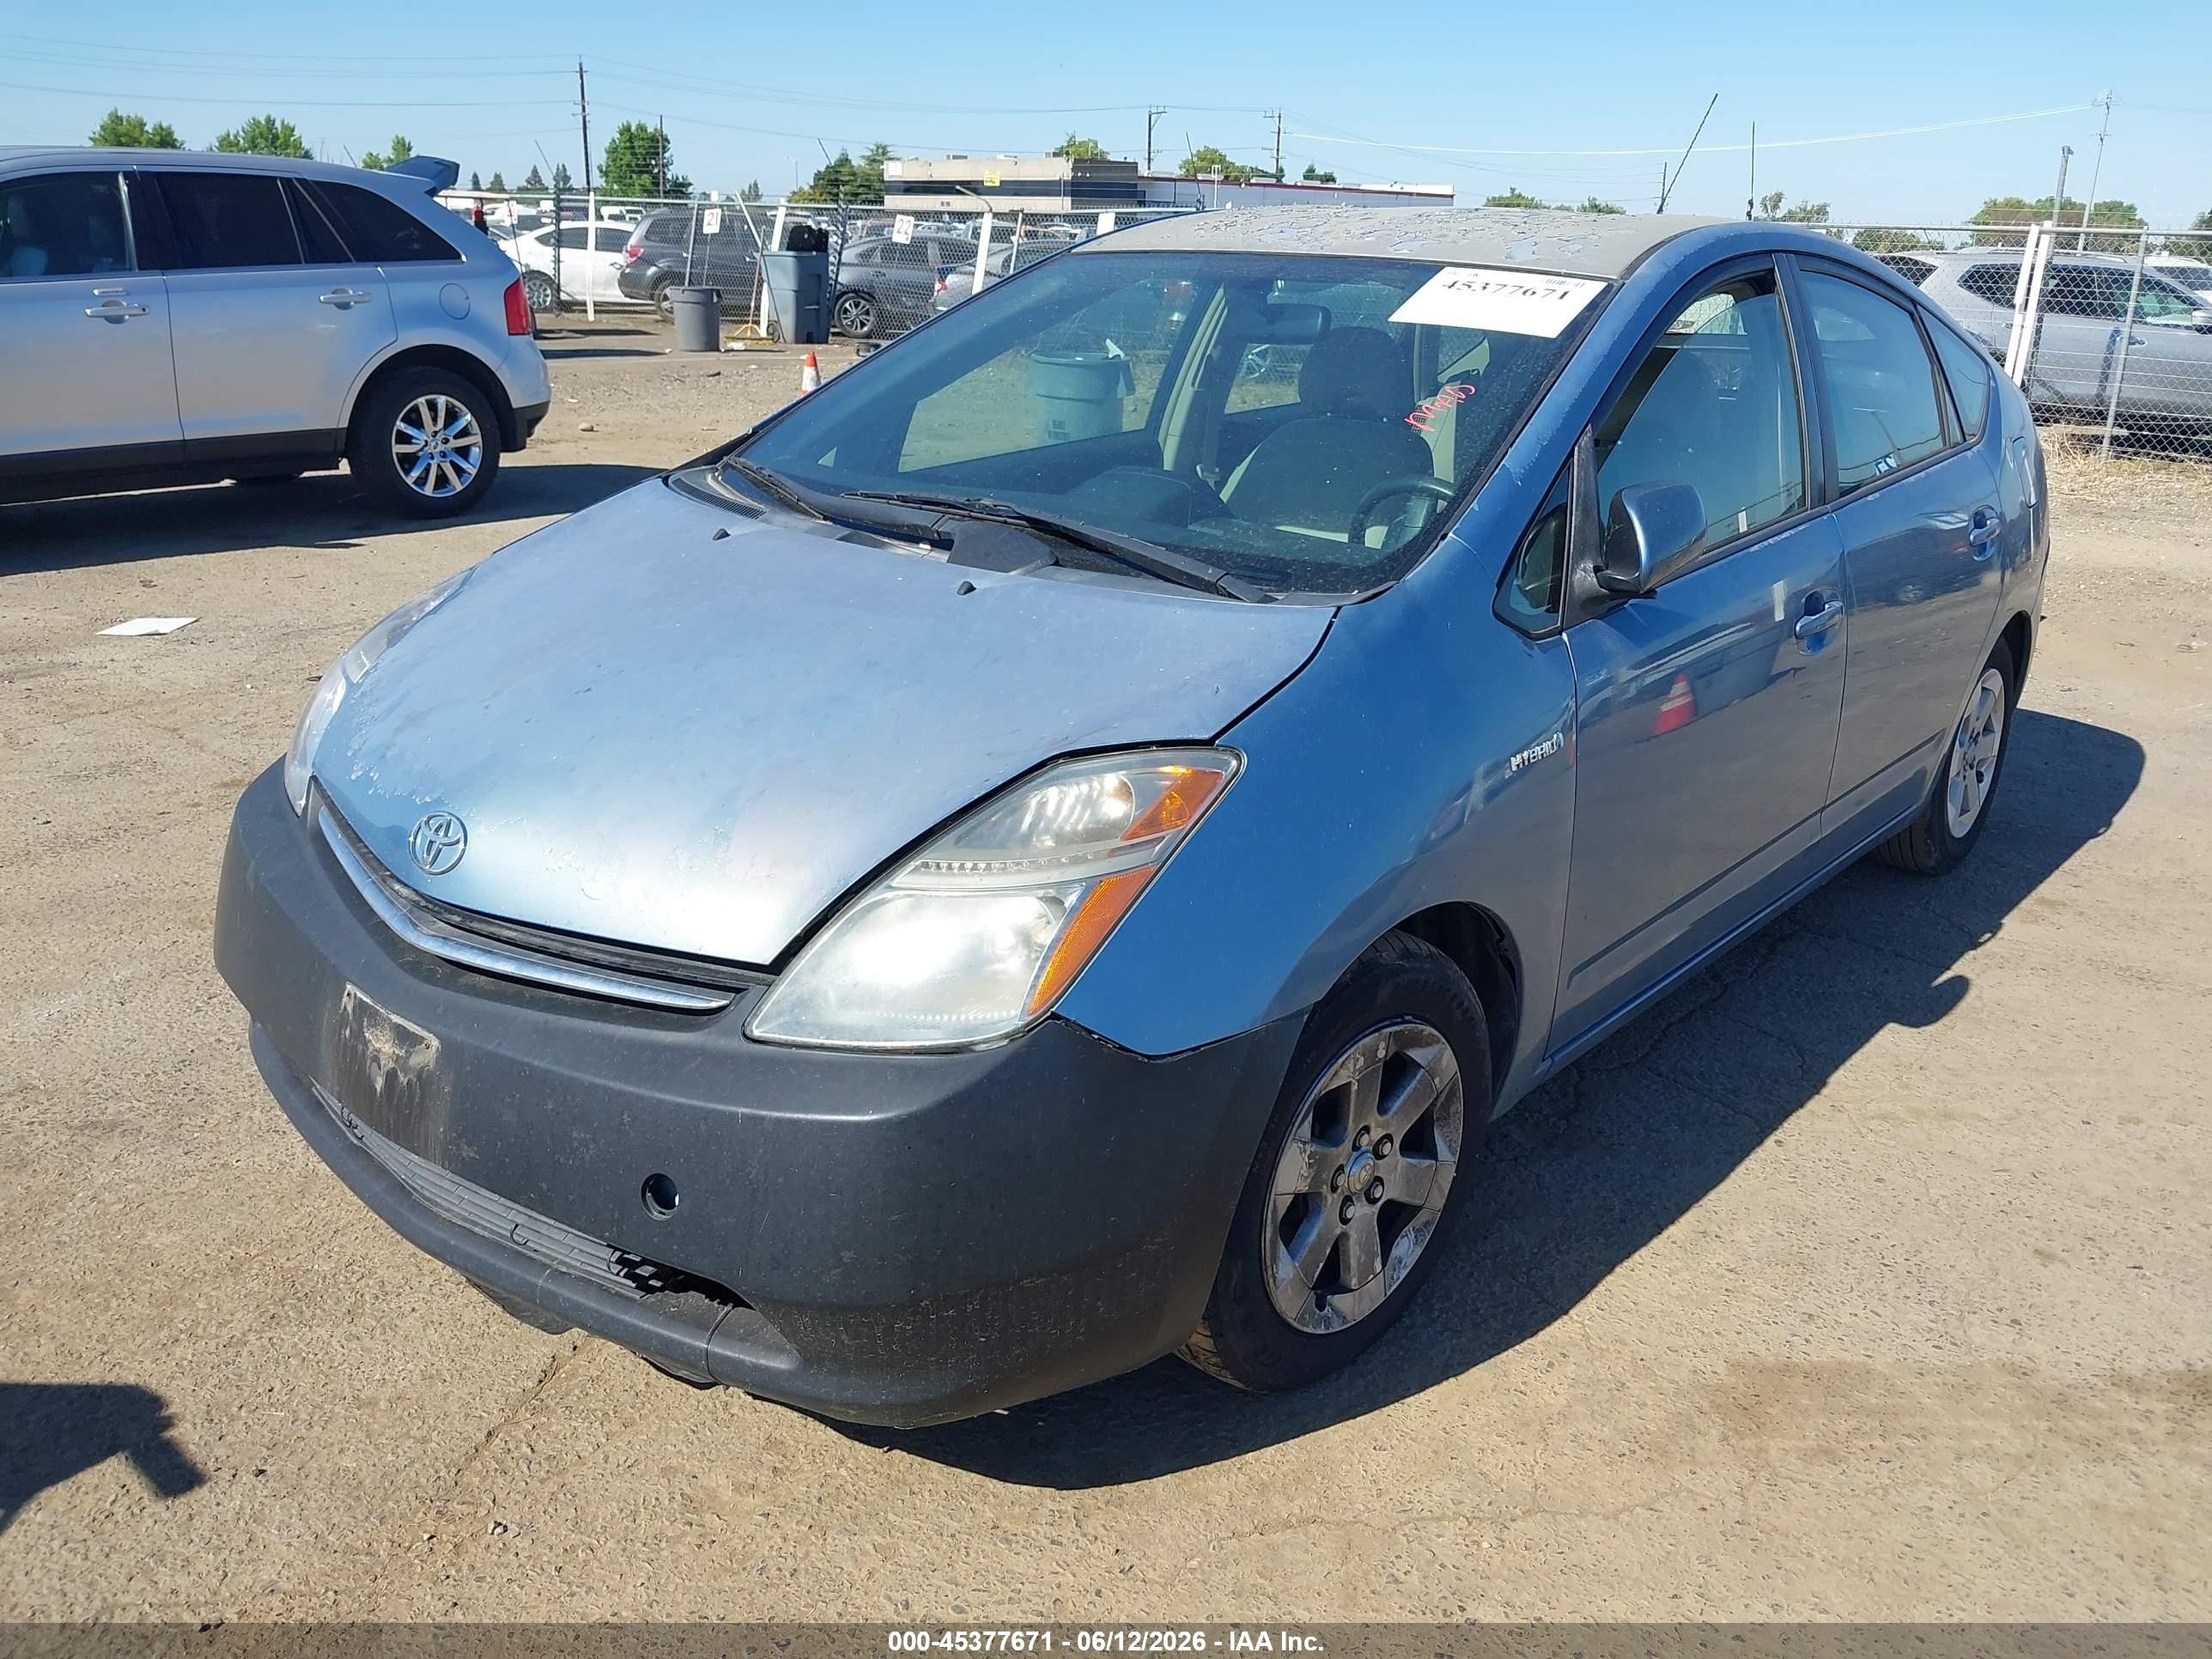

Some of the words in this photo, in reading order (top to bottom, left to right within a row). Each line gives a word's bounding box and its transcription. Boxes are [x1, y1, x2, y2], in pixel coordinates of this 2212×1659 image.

[707, 211, 719, 227] 21
[896, 218, 911, 235] 22
[1443, 280, 1571, 301] 45377671
[1510, 735, 1560, 771] HYBRID
